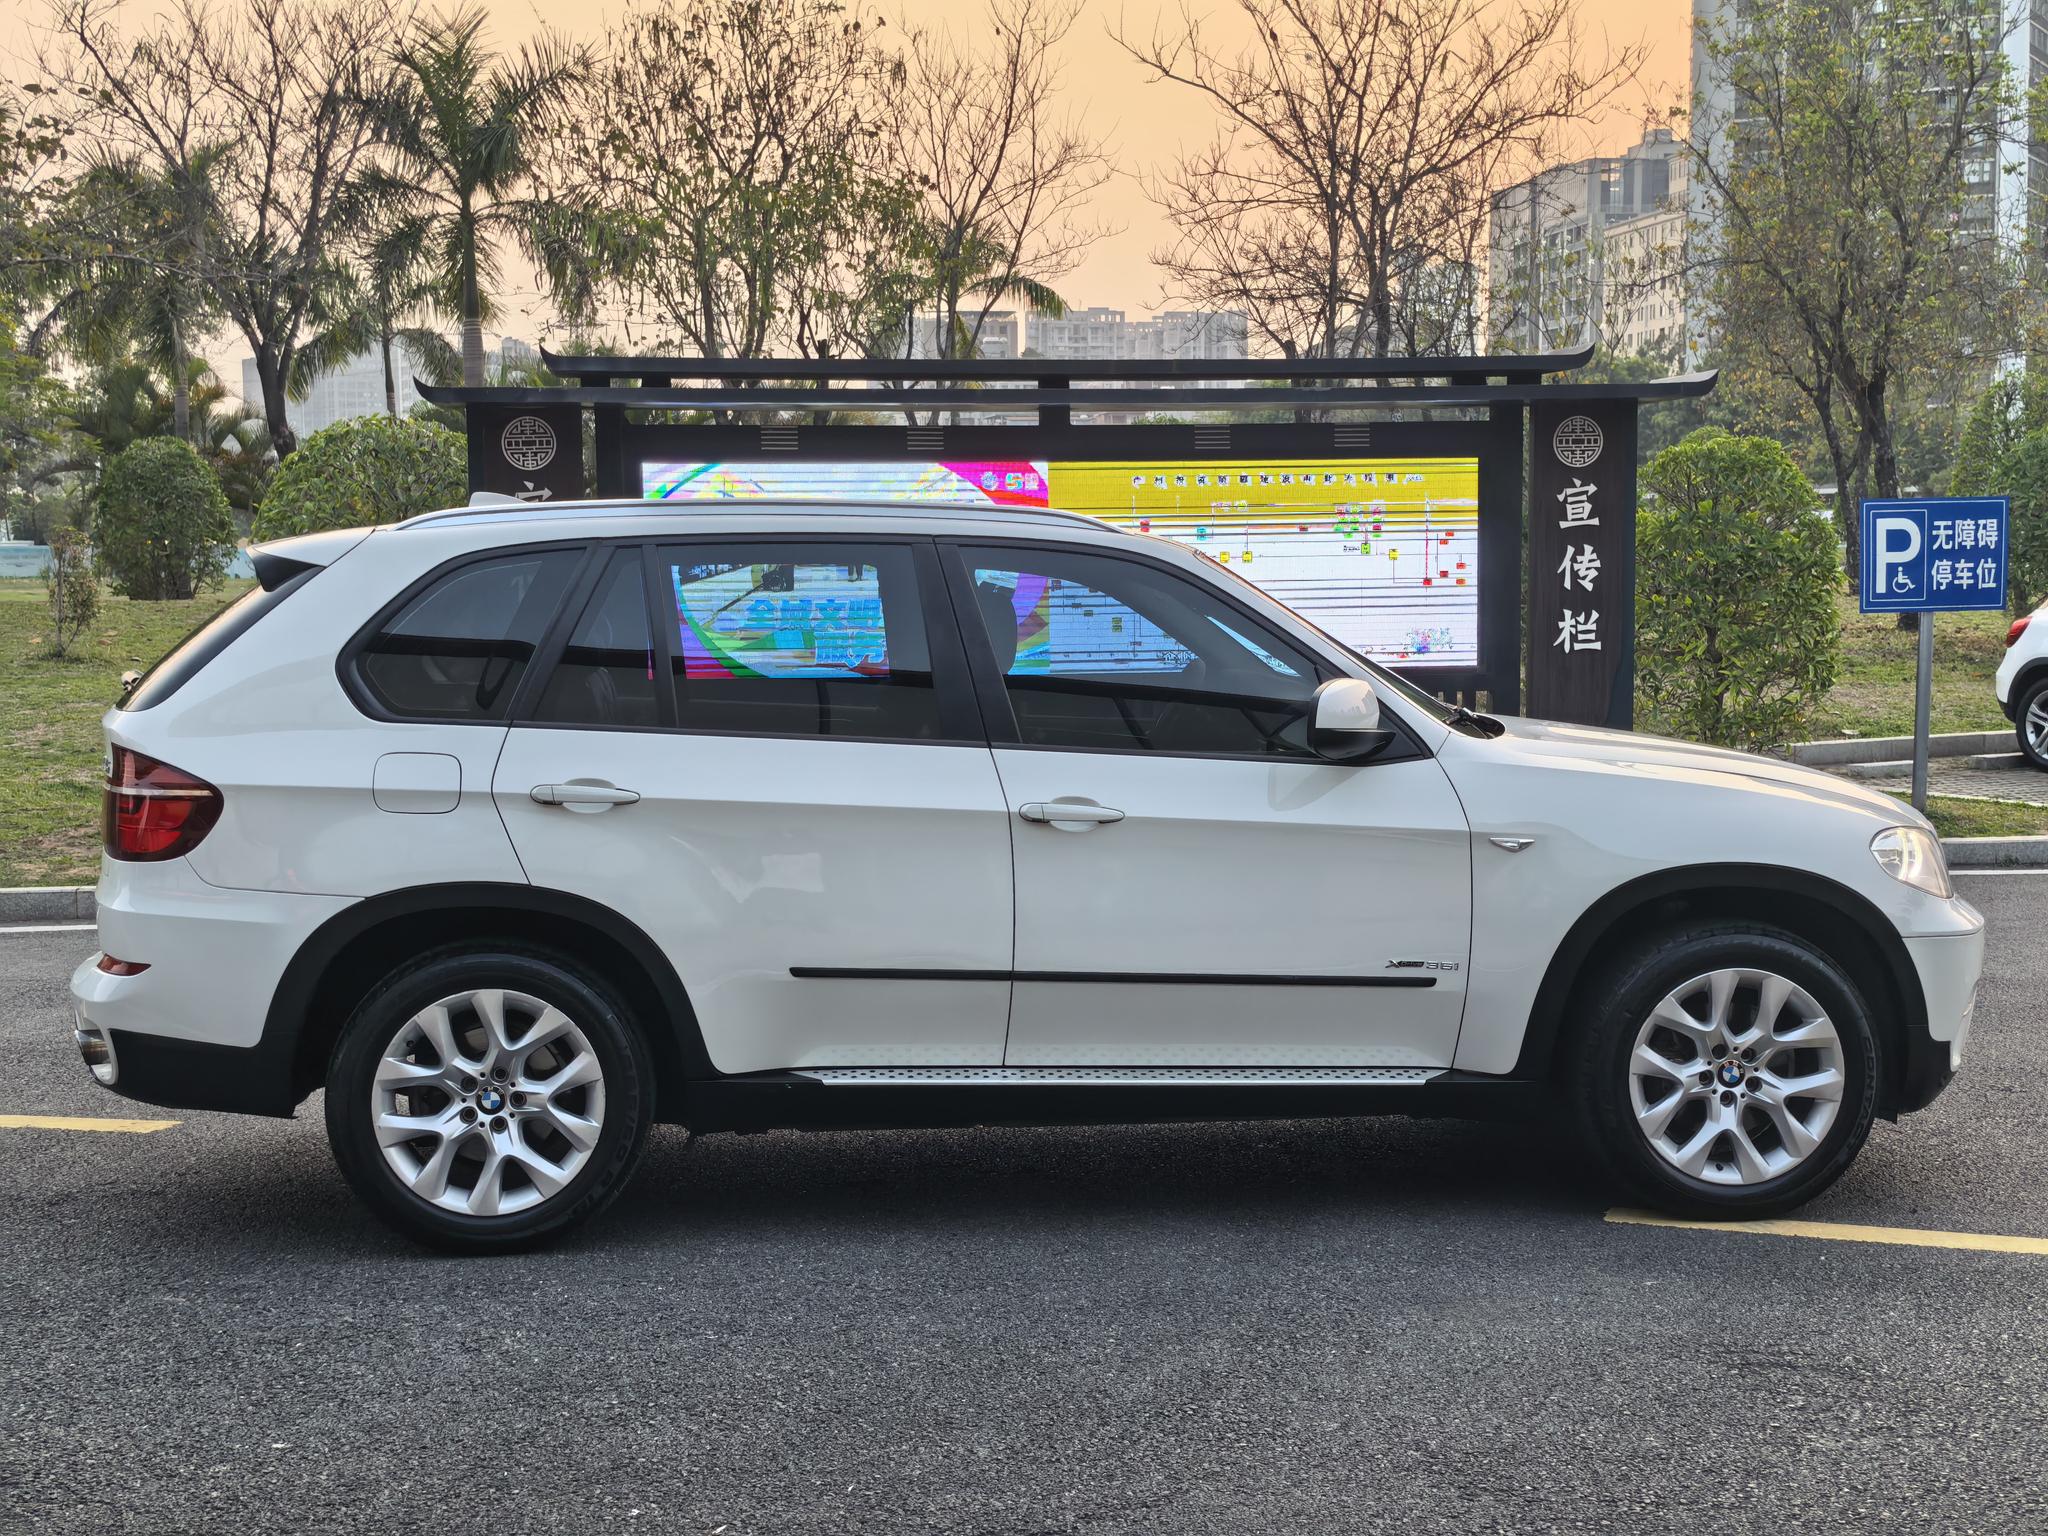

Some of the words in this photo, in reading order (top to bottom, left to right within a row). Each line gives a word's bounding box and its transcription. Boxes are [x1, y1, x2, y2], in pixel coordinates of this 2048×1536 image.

[1876, 518, 1921, 593] P
[1932, 518, 1998, 550] 无障碍
[1553, 478, 1601, 654] 宣传栏
[1931, 557, 1997, 590] 停车位
